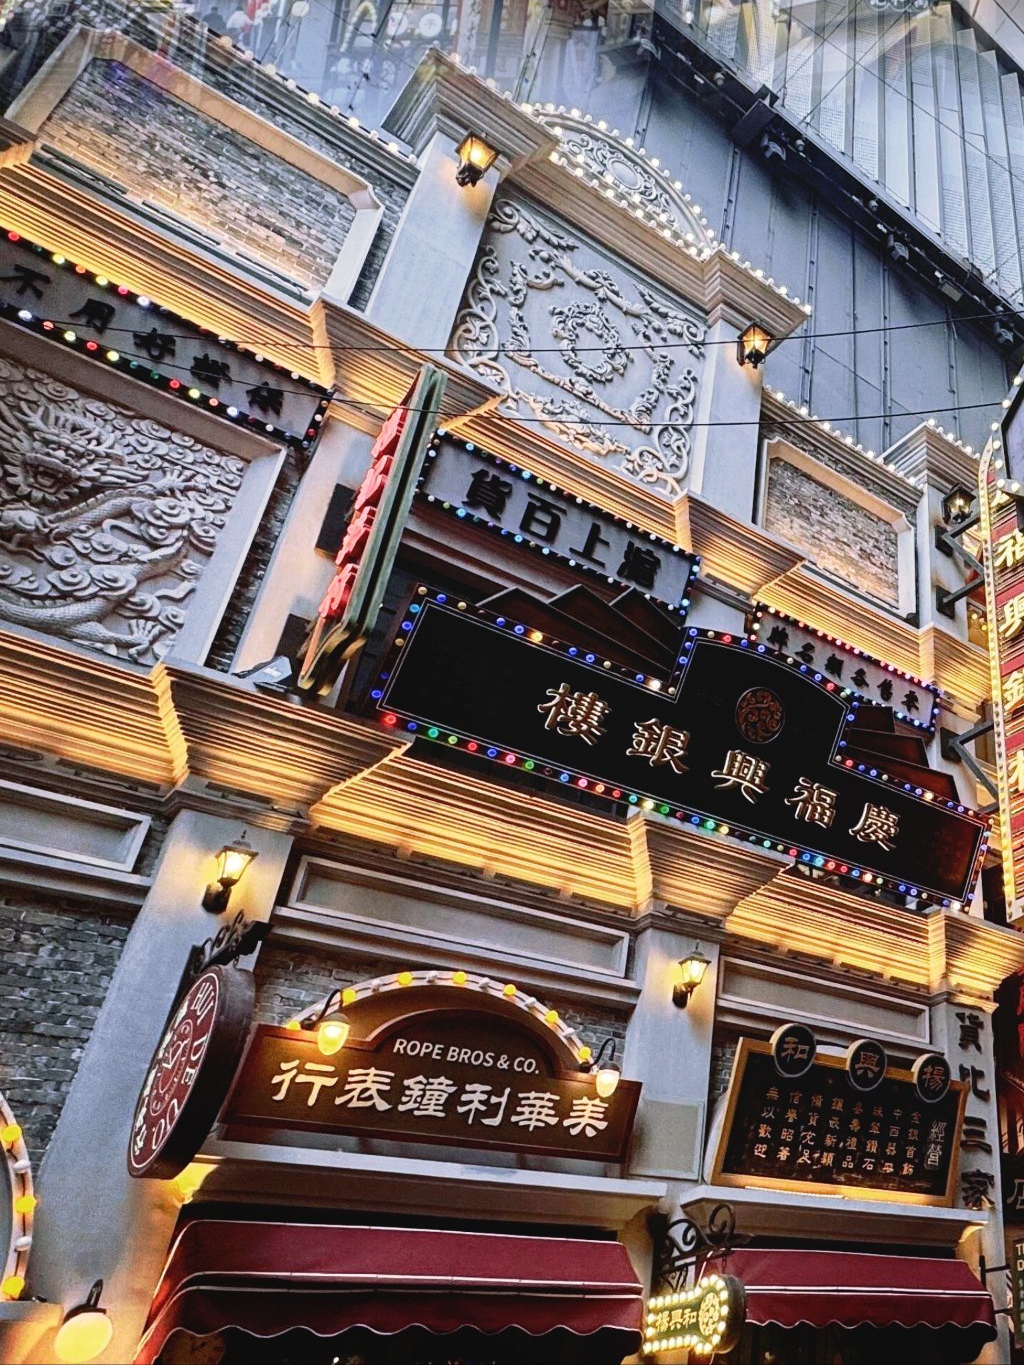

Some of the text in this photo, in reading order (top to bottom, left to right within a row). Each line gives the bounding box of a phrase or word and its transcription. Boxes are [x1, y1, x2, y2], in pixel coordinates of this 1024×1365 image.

[537, 682, 901, 853] 慶福興銀樓
[271, 1059, 609, 1138] 美華利鐘表行
[392, 1037, 540, 1075] ROPE BROS & CO.
[955, 1011, 995, 1211] 貨比三家
